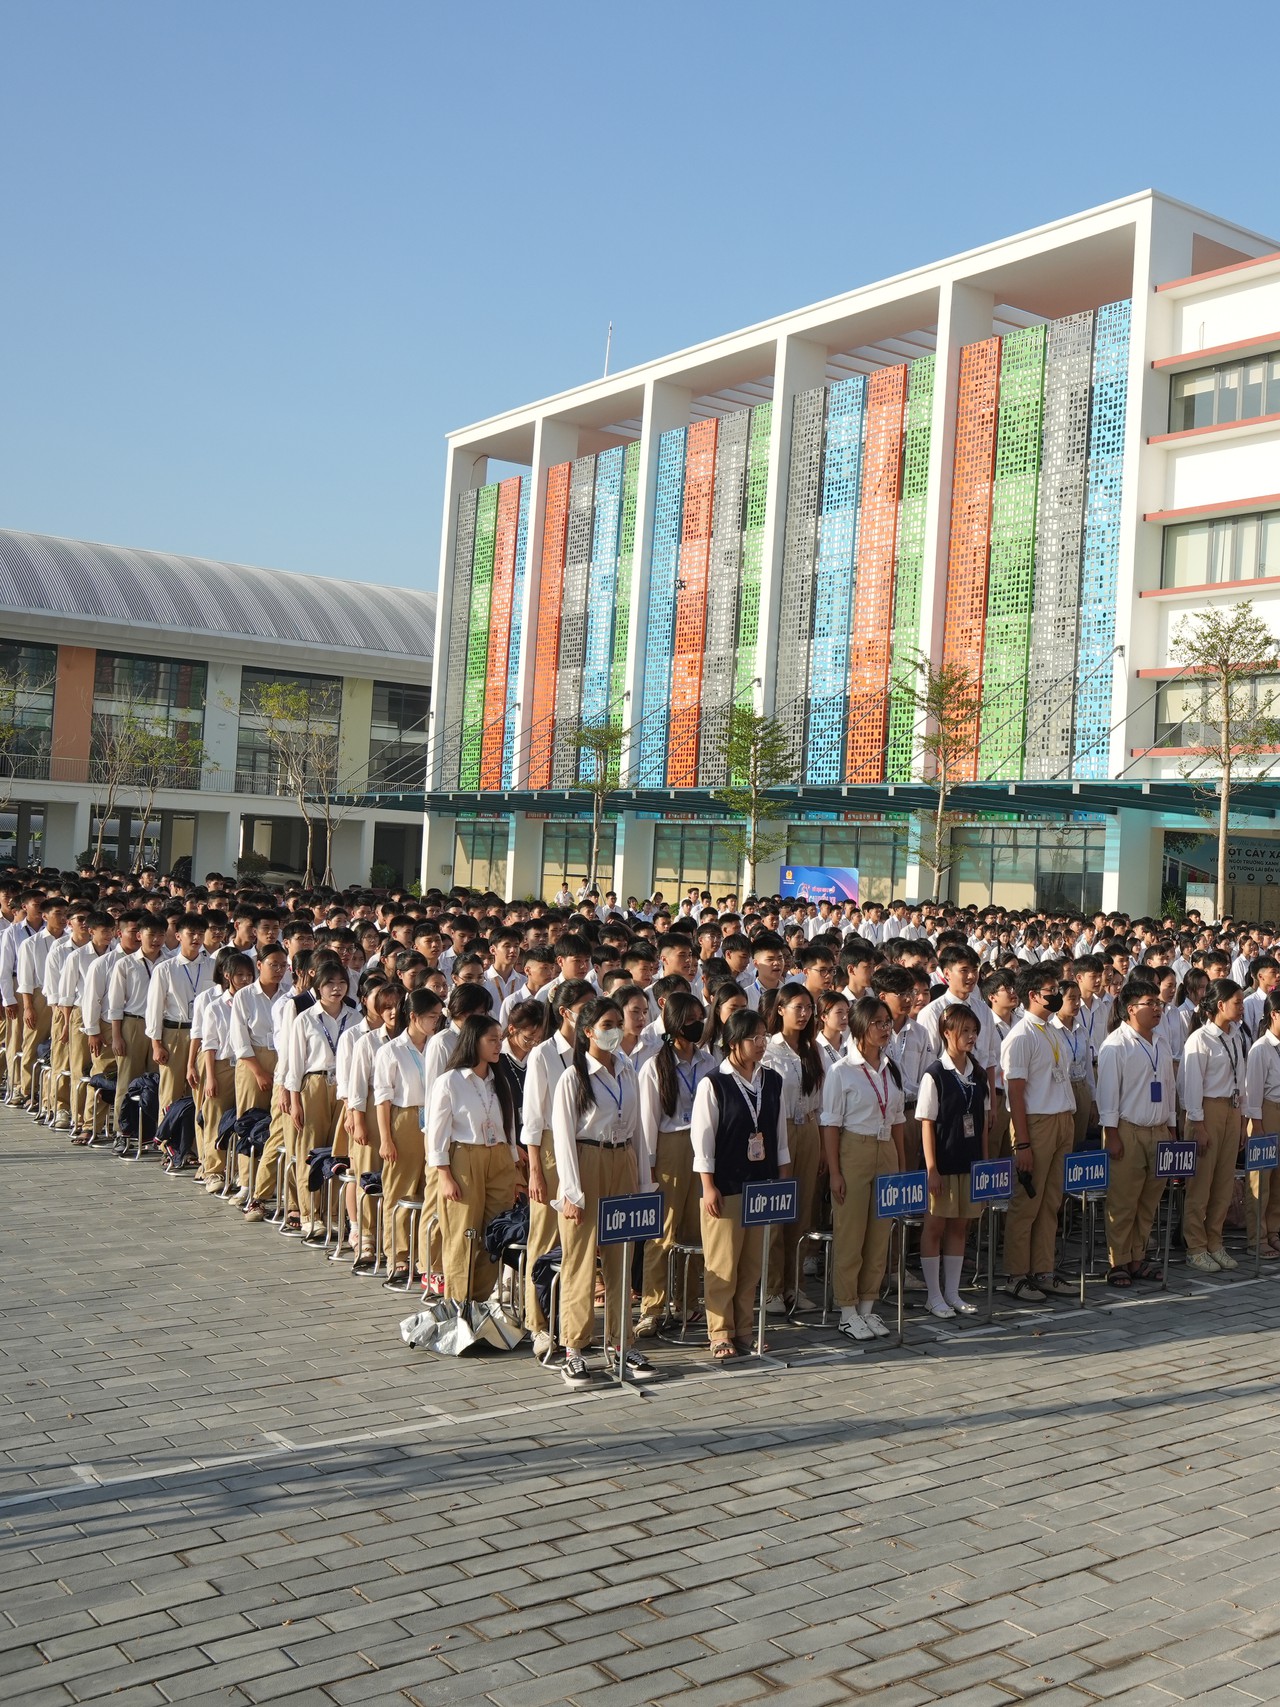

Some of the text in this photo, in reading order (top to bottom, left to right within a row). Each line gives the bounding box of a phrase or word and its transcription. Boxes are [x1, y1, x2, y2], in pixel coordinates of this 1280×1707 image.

[1245, 847, 1266, 858] CÂY
[1159, 1147, 1194, 1171] LỚP 11A3
[1249, 1145, 1277, 1162] LỚP 11A2
[975, 1171, 1009, 1190] LỚP 11A5
[1068, 1164, 1104, 1182] LỚP 11A4
[749, 1193, 792, 1213] LỚP 11A7
[881, 1184, 923, 1207] LỚP 11A6
[606, 1208, 656, 1231] LỚP 11A8
